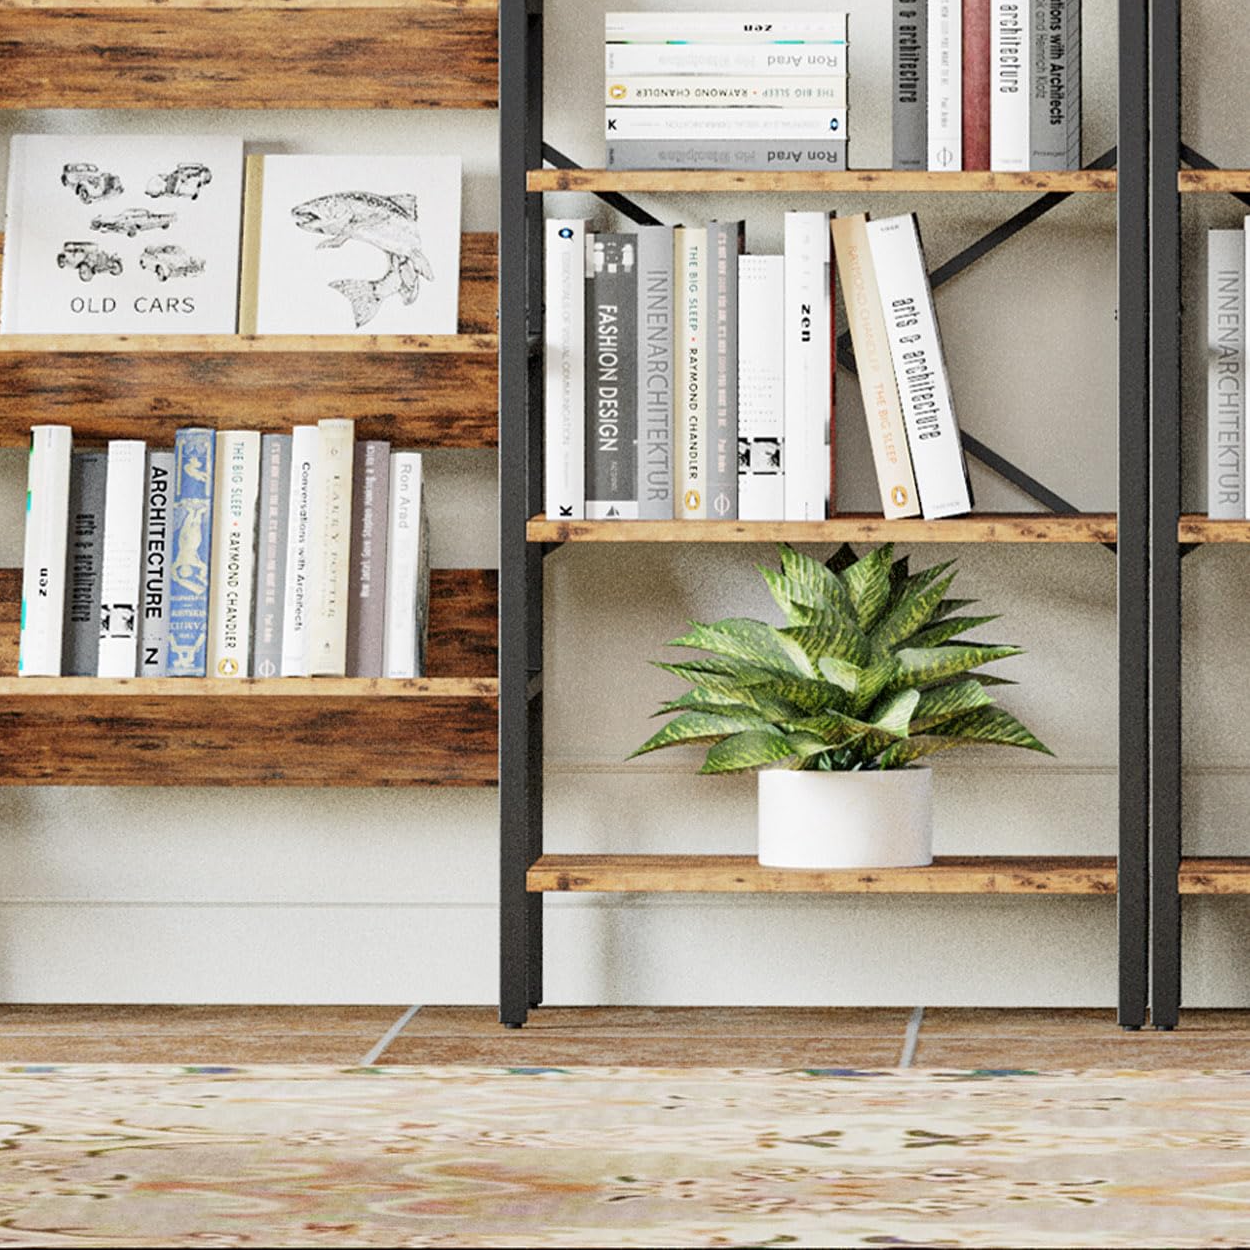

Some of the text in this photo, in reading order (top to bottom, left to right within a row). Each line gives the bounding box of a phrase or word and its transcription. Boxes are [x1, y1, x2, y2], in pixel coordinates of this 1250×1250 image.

[743, 24, 773, 32] zen
[899, 10, 917, 19] &
[1036, 13, 1047, 30] and
[767, 55, 803, 67] Arad
[807, 55, 838, 67] Ron
[1000, 4, 1023, 94] architecture
[1050, 34, 1065, 60] with
[899, 25, 921, 103] architecture
[636, 89, 835, 97] THE BIG SLEEP RAYMOND CHANDLER
[1036, 76, 1048, 99] Klotz
[1050, 63, 1065, 125] Architects
[767, 151, 803, 163] Arad
[807, 151, 838, 163] Ron
[71, 297, 195, 314] OLD CARS
[892, 297, 920, 328] arts
[800, 303, 811, 343] zen
[598, 304, 618, 381] FASHION
[688, 246, 698, 479] THE BIG SLEEP RAYMOND CHANDLER
[647, 269, 669, 501] INNENARCHITEKTUR
[873, 382, 886, 410] THE
[902, 350, 941, 440] architecture
[1217, 270, 1239, 505] INNENARCHITEKTUR
[598, 387, 618, 452] DESIGN
[878, 411, 891, 435] BIG
[883, 436, 898, 465] SLEEP
[398, 464, 411, 529] Ron Arad
[559, 505, 572, 516] K
[75, 514, 95, 535] arts
[145, 466, 168, 619] ARCHITECTURE
[225, 442, 244, 649] THE BIG SLEEP RAYMOND CHANDLER
[294, 462, 311, 632] Conversations with Architects
[38, 567, 48, 597] zen
[71, 555, 95, 622] architecture
[145, 648, 158, 664] N
